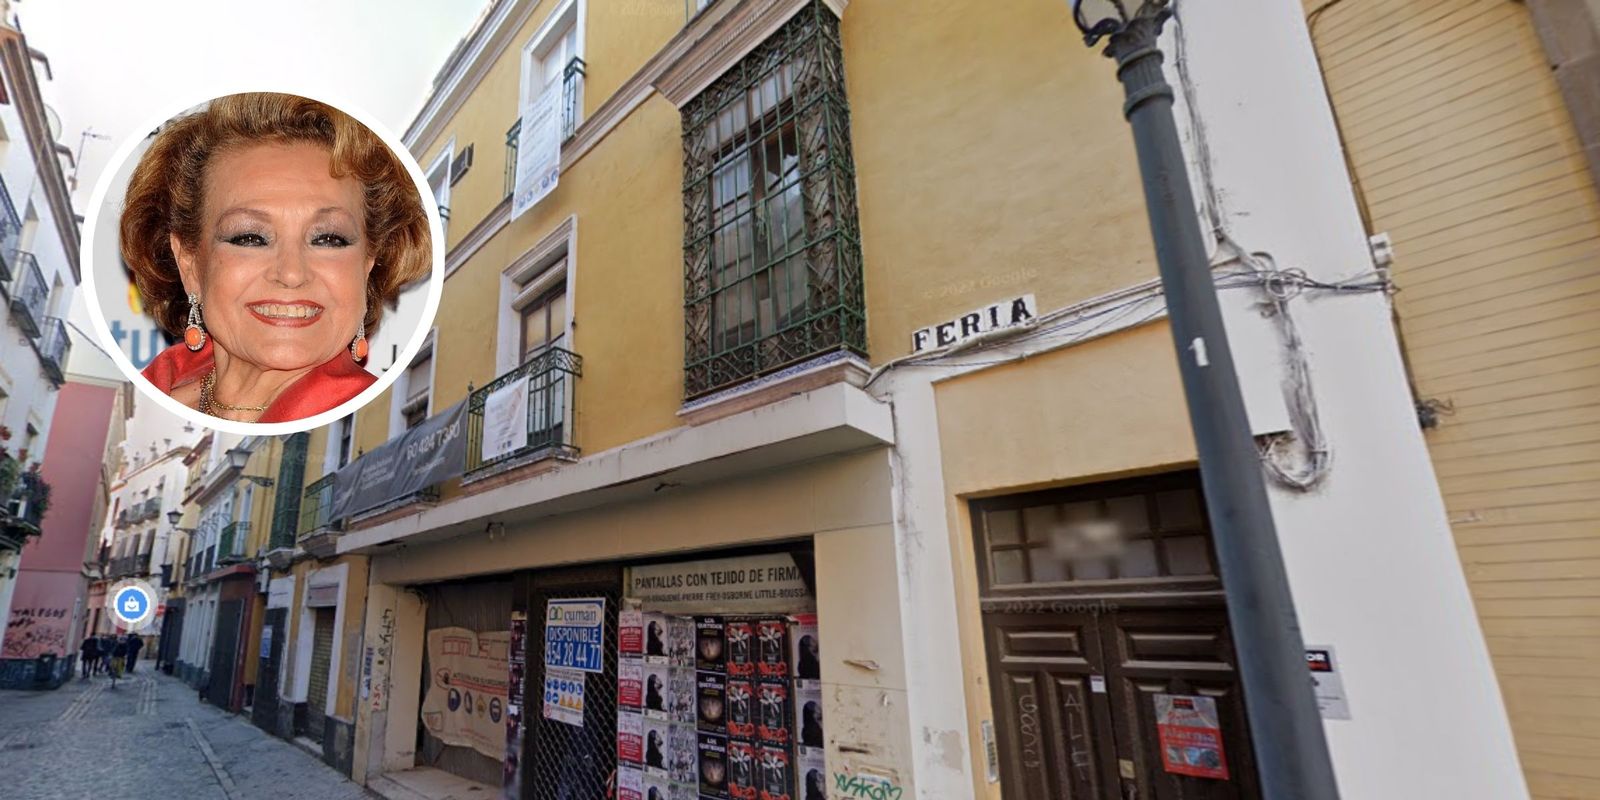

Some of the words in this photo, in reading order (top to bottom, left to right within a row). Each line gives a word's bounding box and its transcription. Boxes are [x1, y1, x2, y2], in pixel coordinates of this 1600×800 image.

[913, 297, 1032, 351] FERIA
[635, 575, 683, 589] PANTALLAS
[686, 573, 708, 587] CON
[711, 569, 746, 585] TEJIDO
[749, 568, 764, 583] DE
[548, 627, 600, 643] DISPONIBLE
[563, 642, 574, 666] 28
[576, 643, 588, 668] 44
[590, 644, 601, 669] 77
